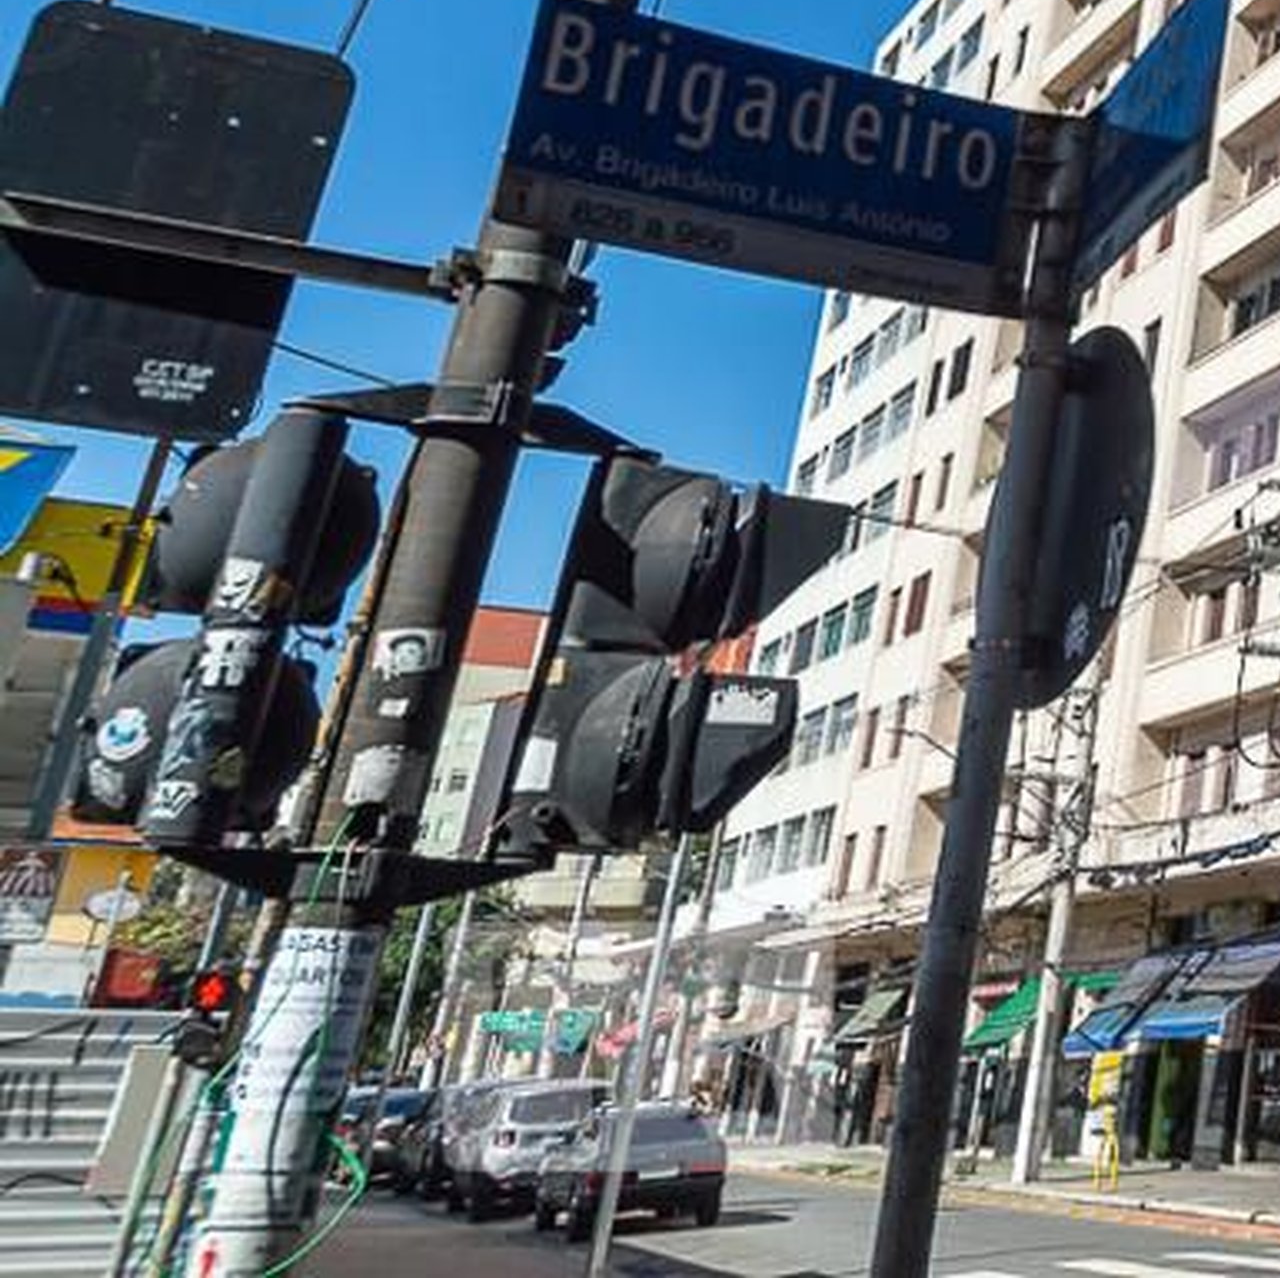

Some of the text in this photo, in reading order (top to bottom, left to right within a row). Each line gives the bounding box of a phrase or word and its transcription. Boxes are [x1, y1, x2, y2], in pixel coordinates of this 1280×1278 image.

[541, 12, 997, 190] Brigadeiro
[531, 132, 583, 166] Av.
[596, 143, 759, 204] Brigadeiro
